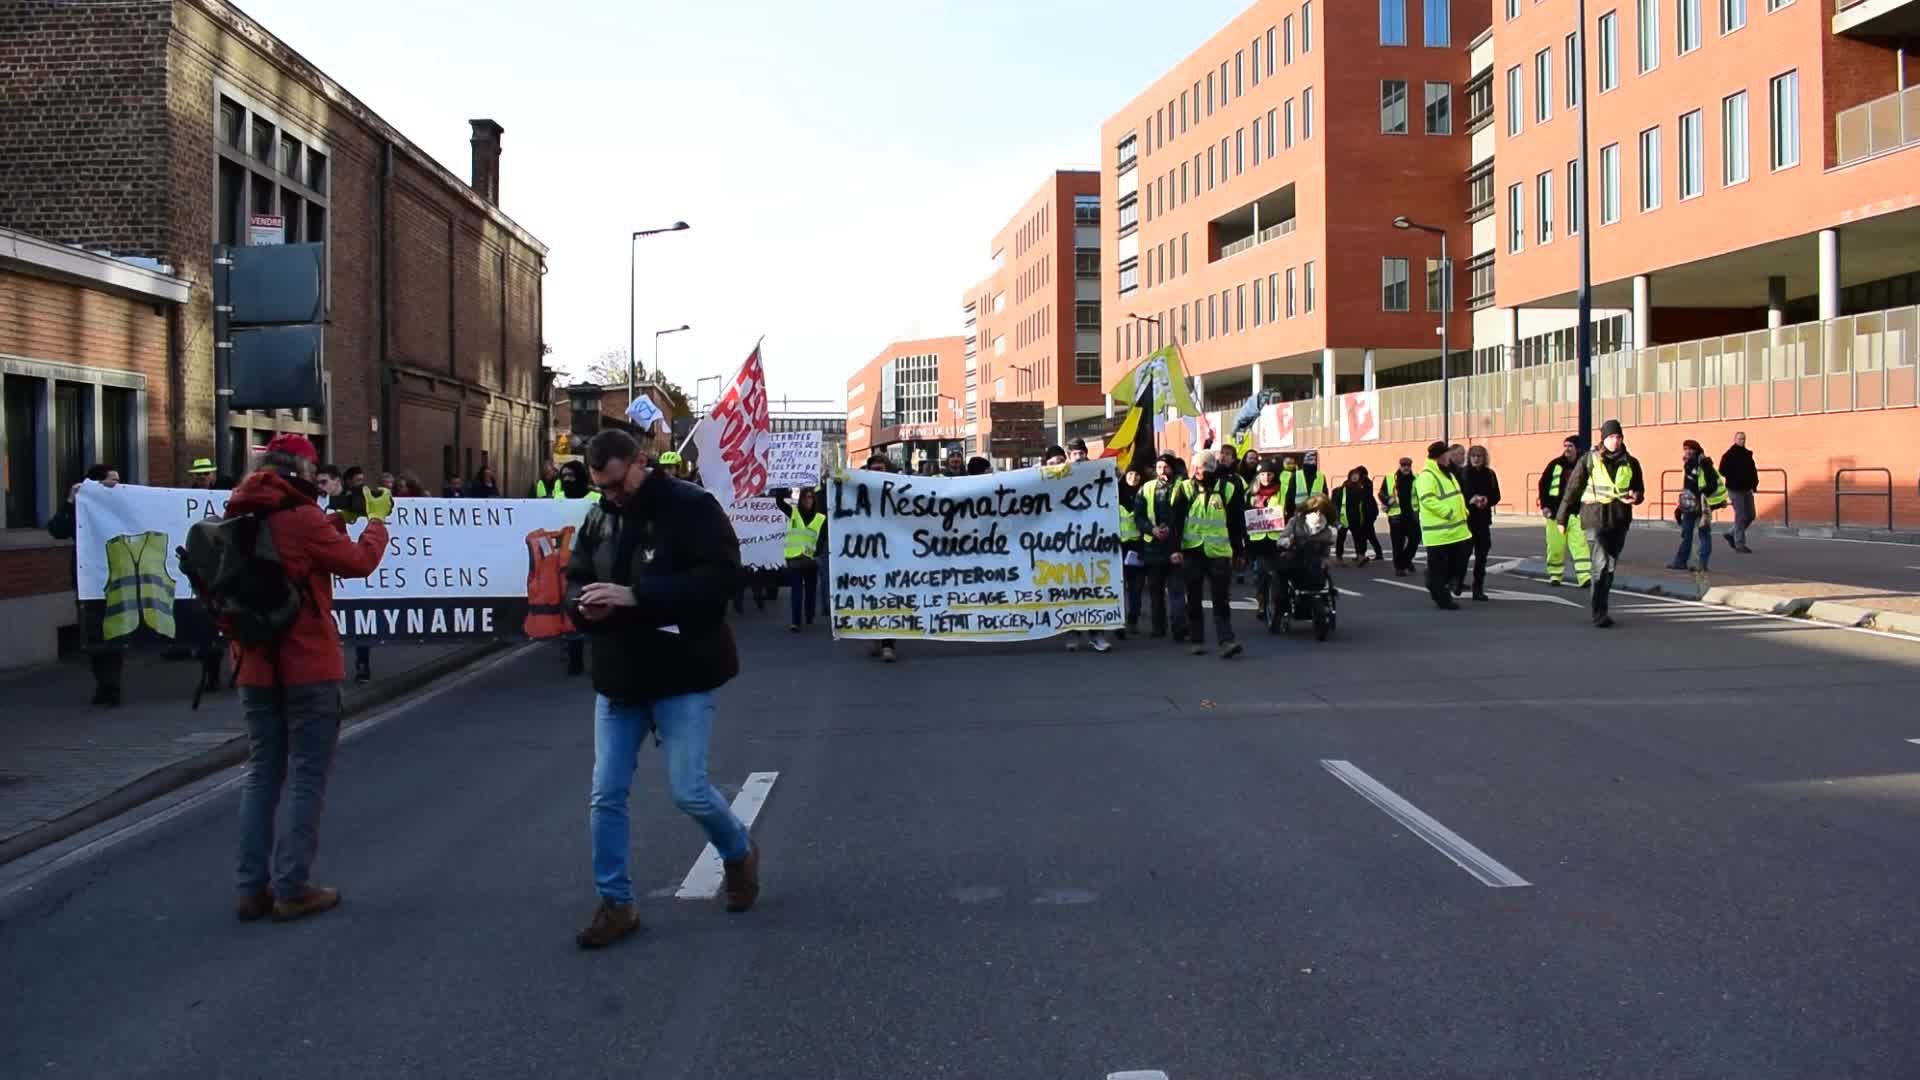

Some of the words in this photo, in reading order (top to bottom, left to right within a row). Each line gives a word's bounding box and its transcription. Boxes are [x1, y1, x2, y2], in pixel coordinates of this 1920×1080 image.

[834, 481, 872, 519] LA
[880, 480, 1052, 531] Résignation
[1061, 469, 1113, 511] est
[390, 536, 433, 556] SSE
[839, 531, 890, 559] un
[424, 567, 488, 587] GENS
[835, 594, 855, 611] LA
[924, 594, 942, 608] LE
[1014, 589, 1043, 604] DES
[331, 608, 493, 634] NMYNAME
[1035, 610, 1051, 628] LA
